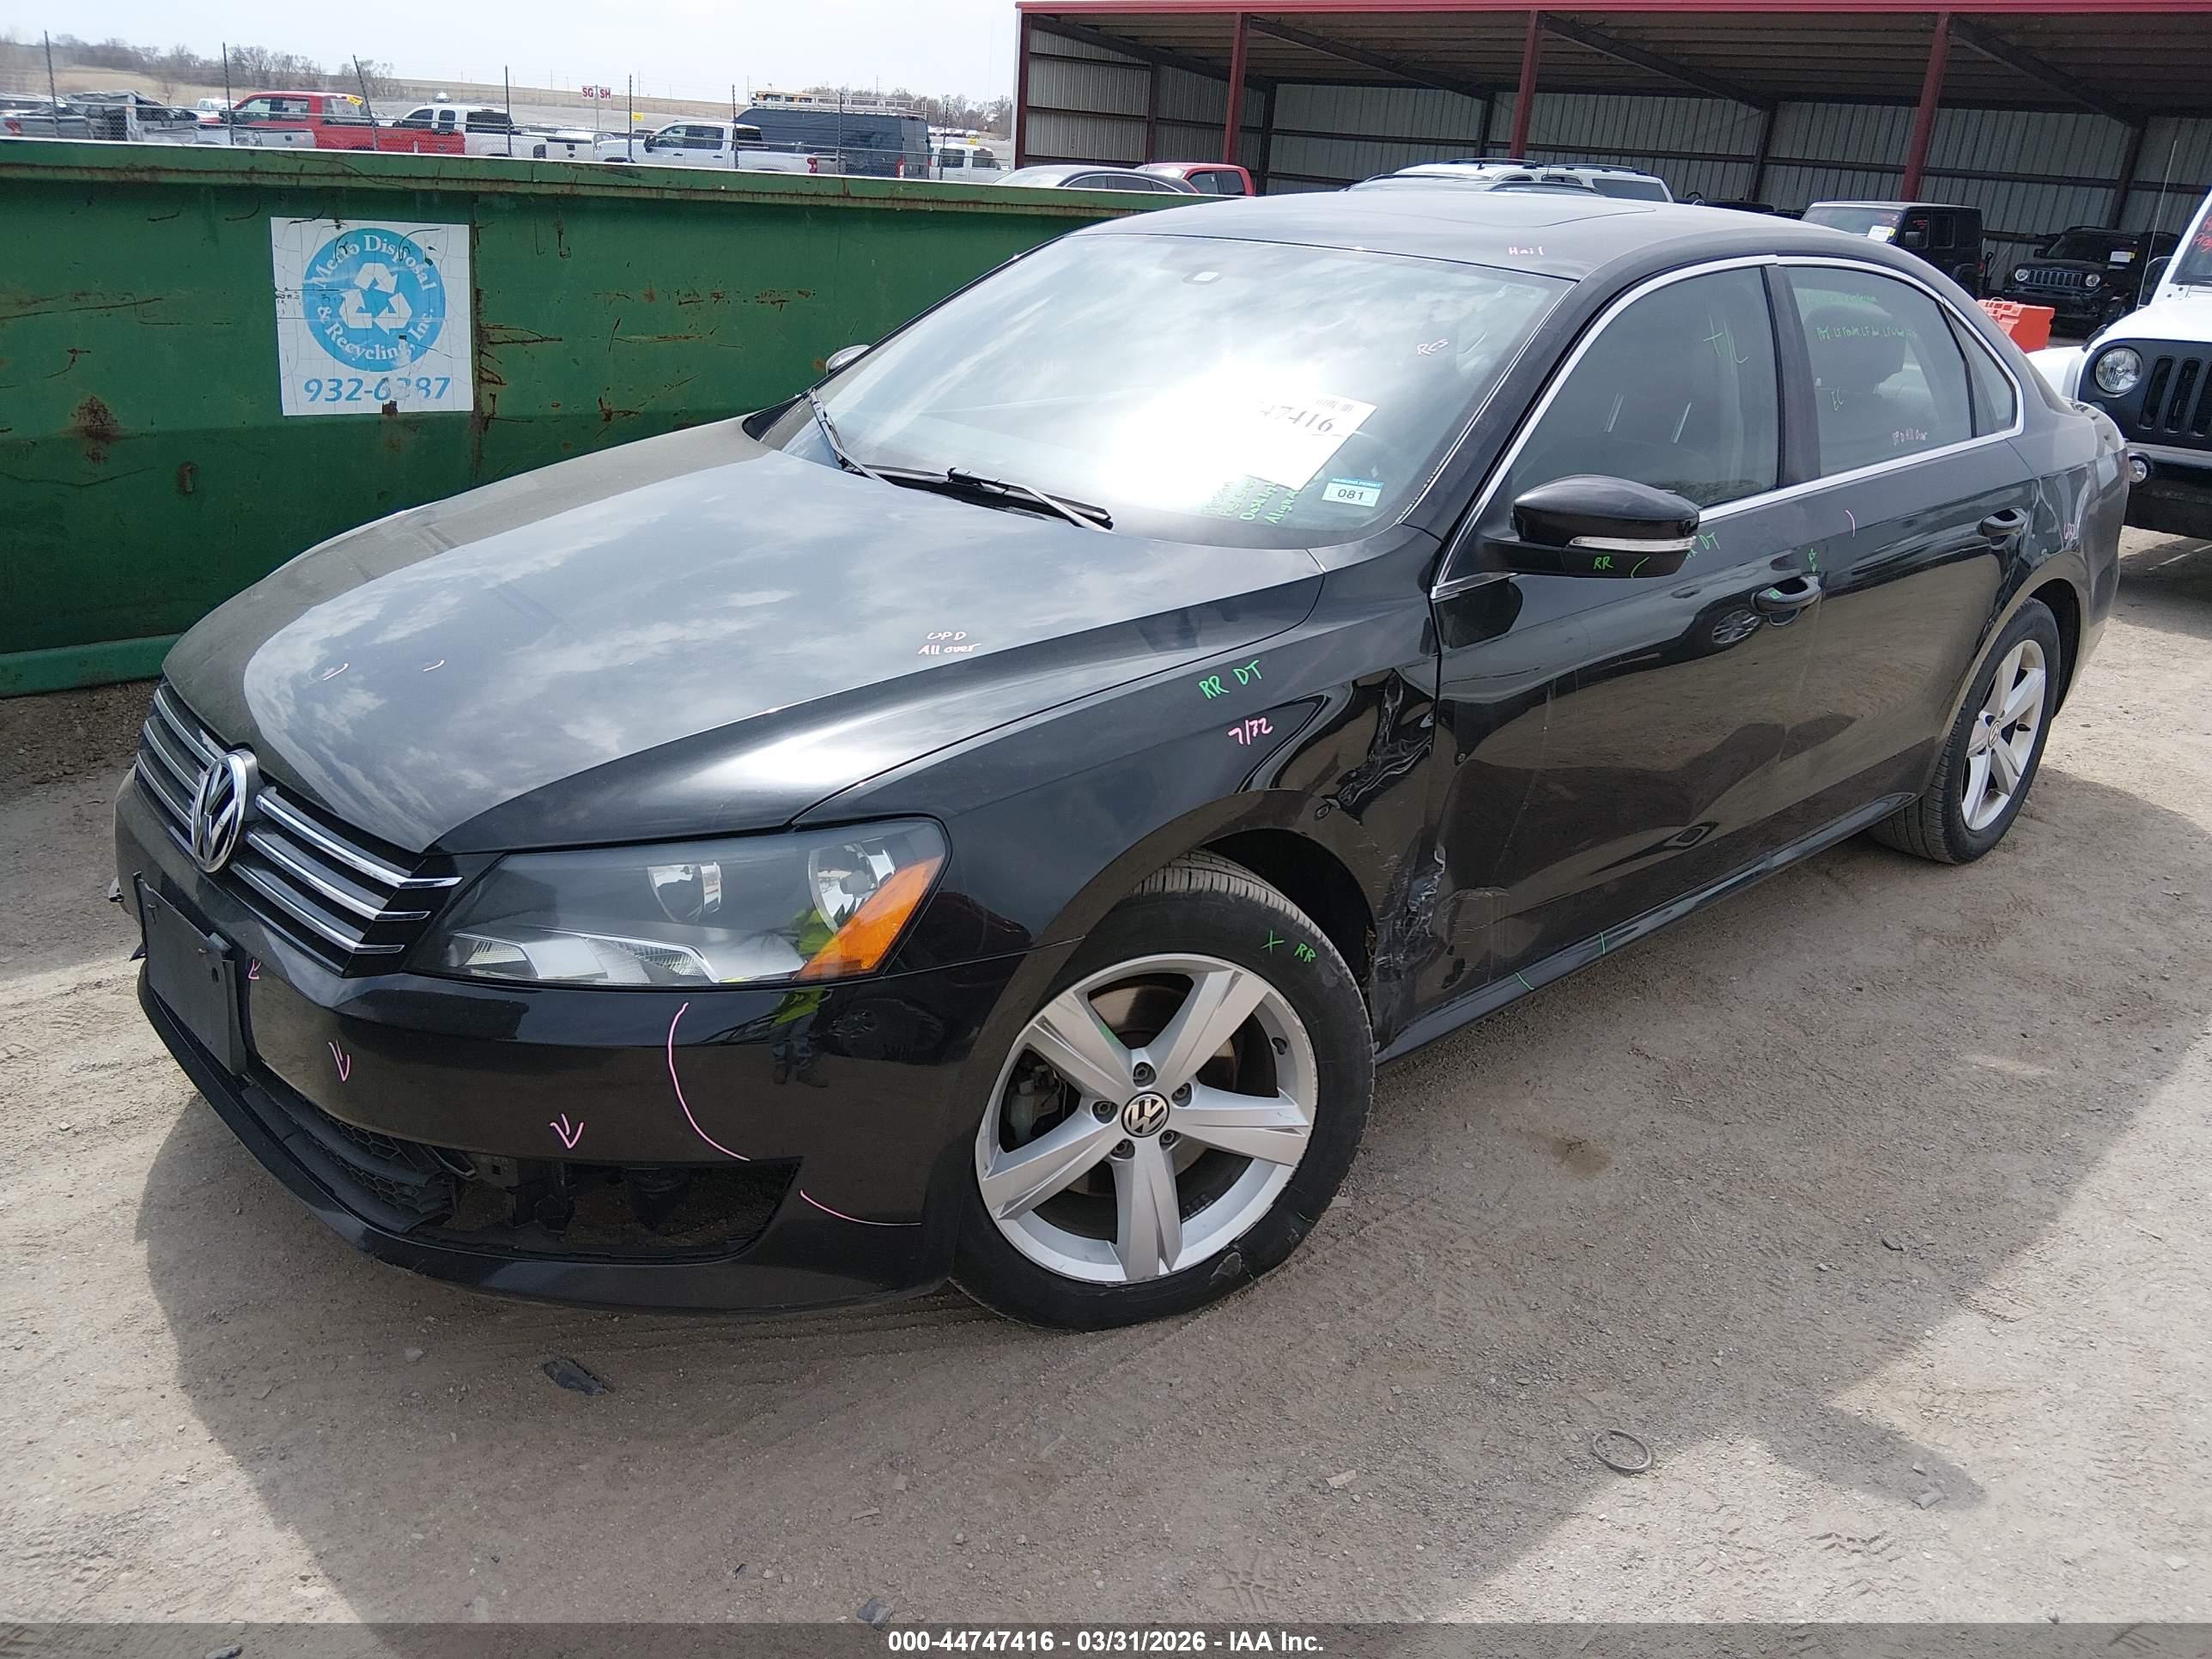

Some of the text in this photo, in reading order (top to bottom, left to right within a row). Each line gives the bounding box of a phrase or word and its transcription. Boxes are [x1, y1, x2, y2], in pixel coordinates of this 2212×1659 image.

[582, 87, 594, 98] SG
[599, 88, 611, 100] SH
[363, 234, 437, 291] Disposal
[317, 306, 332, 324] &
[408, 308, 433, 341] Inc.
[1337, 489, 1365, 501] 081
[1593, 556, 1614, 570] RR
[927, 631, 967, 641] UPD
[917, 644, 940, 655] All
[1199, 659, 1262, 700] RR DT
[1293, 943, 1317, 963] RR
